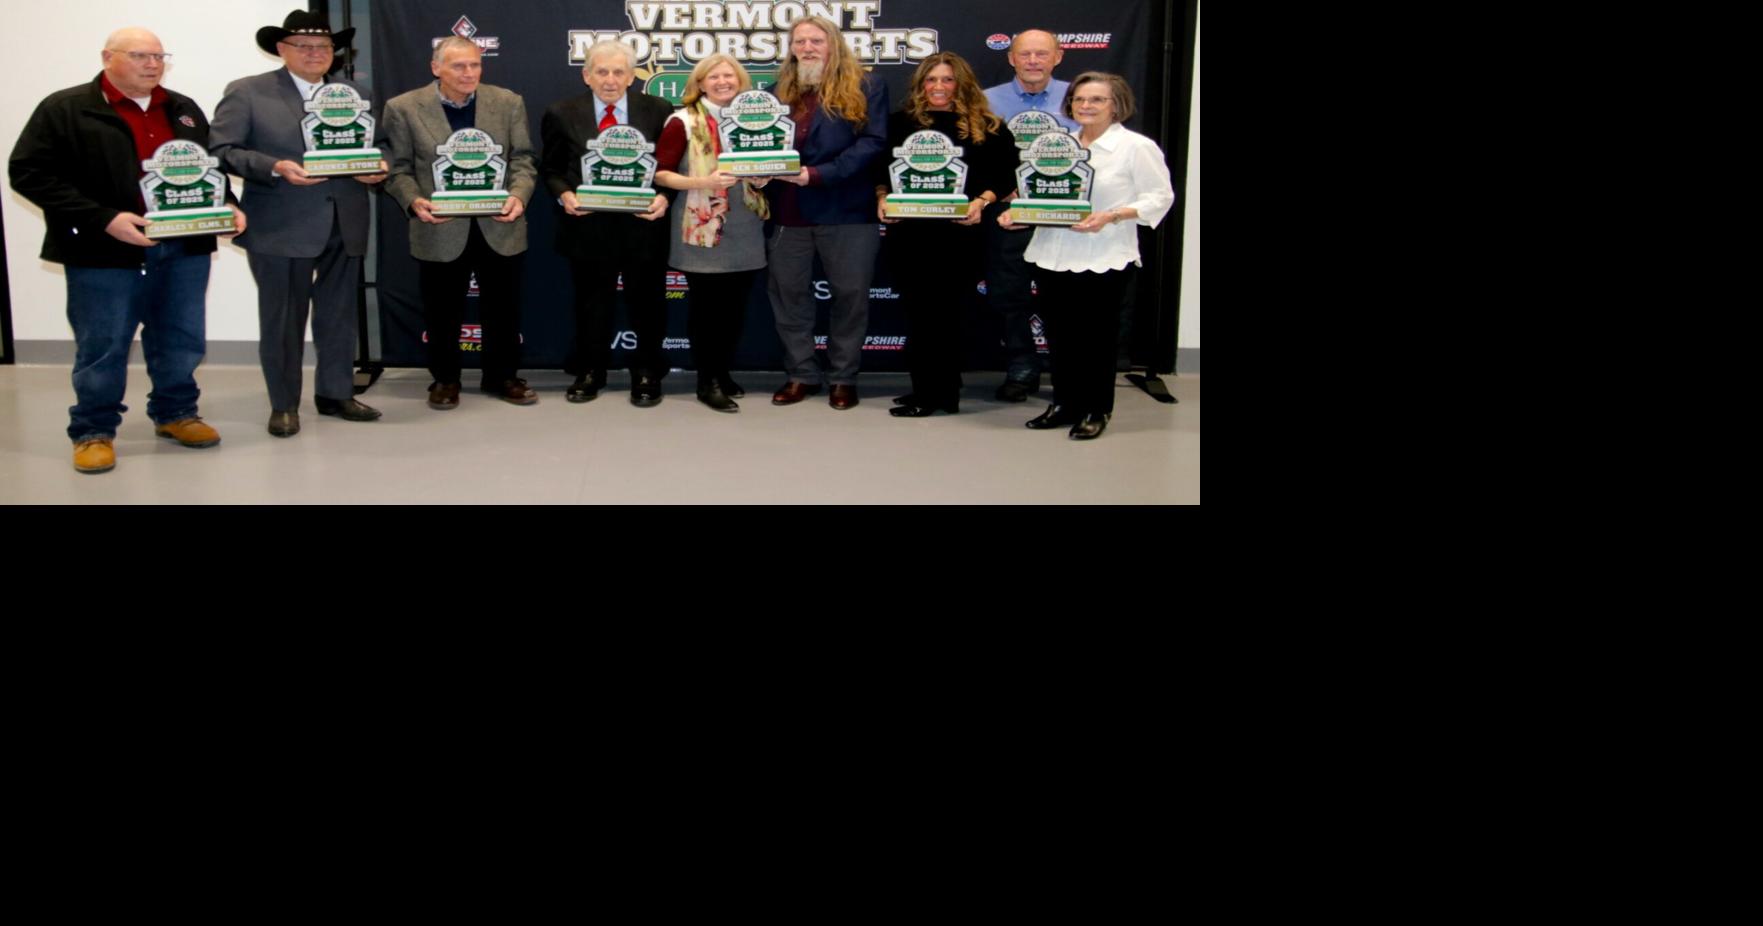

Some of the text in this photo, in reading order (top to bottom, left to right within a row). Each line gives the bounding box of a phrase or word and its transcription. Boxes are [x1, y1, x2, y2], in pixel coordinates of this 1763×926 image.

[629, 1, 876, 31] VERMONT
[1056, 33, 1112, 43] MPSHIRE
[571, 29, 936, 62] MOTORSRTS
[322, 129, 356, 138] CLASS
[739, 132, 774, 141] CLASS
[452, 171, 486, 180] CLASS
[601, 167, 635, 176] CLASS
[910, 175, 945, 183] CLASS
[1036, 179, 1070, 188] CLASS
[165, 187, 204, 198] CLASS
[920, 206, 957, 214] CURLEY
[863, 336, 907, 345] PSHIRE
